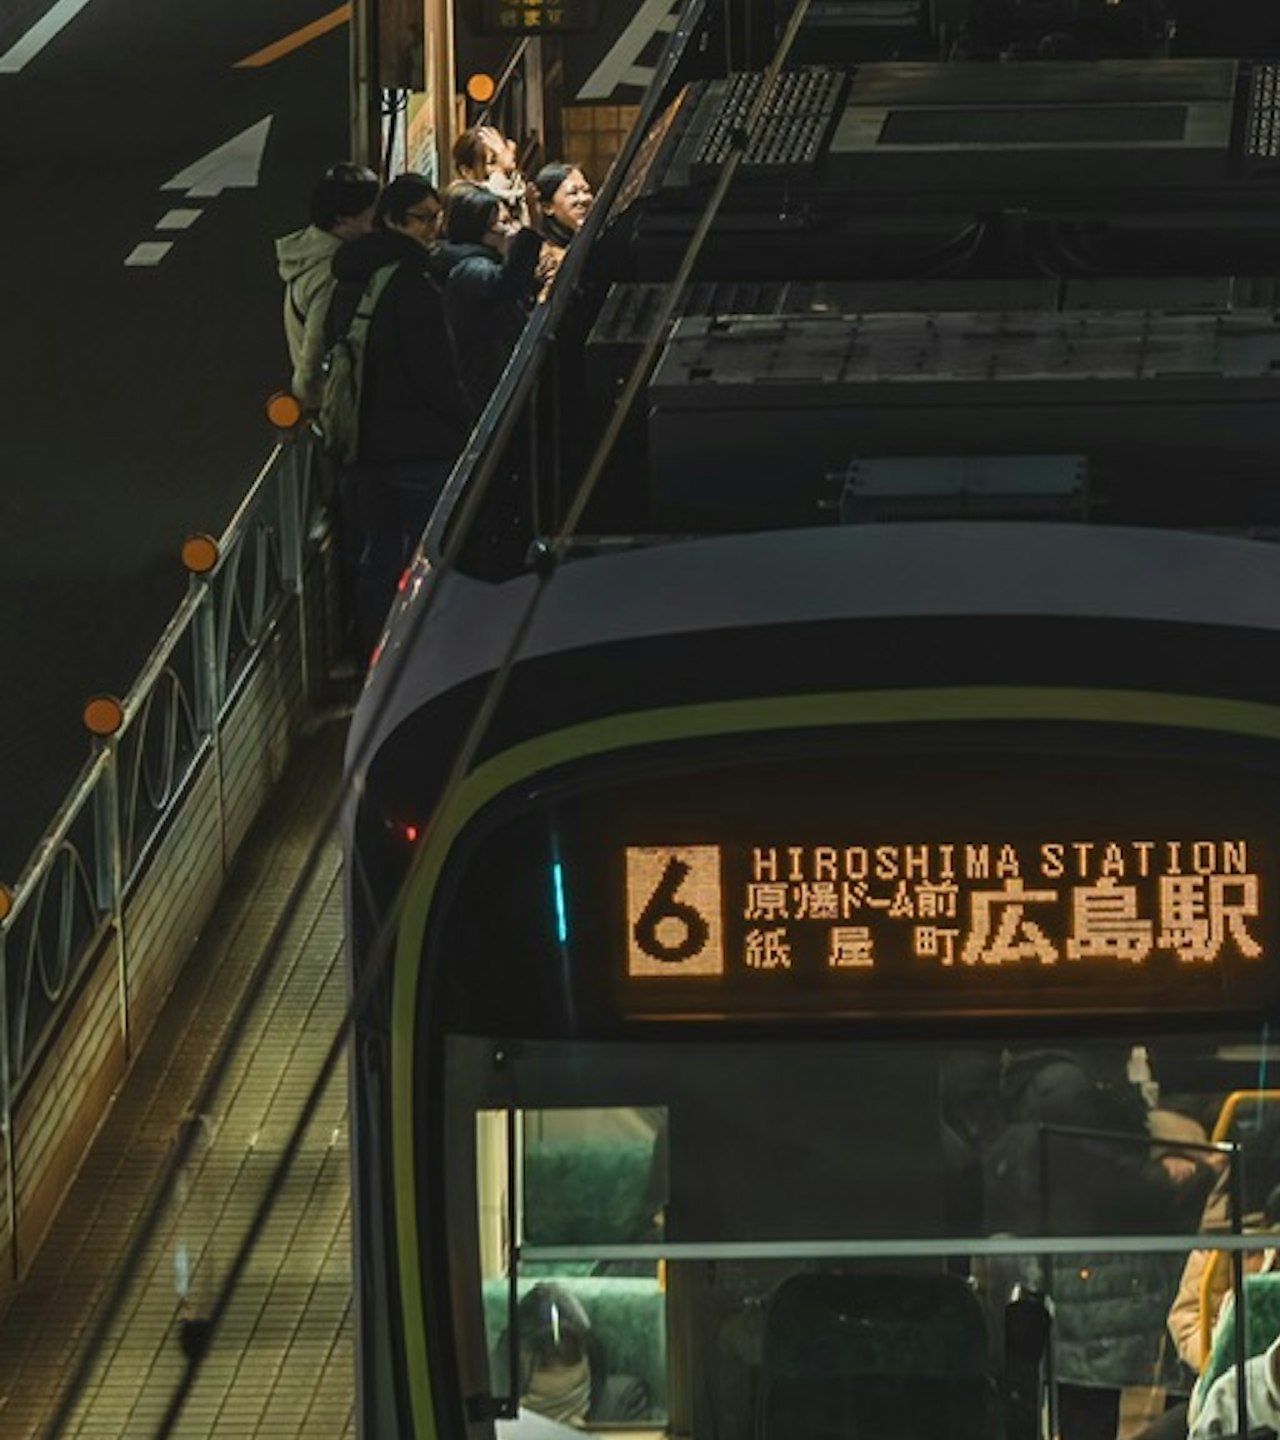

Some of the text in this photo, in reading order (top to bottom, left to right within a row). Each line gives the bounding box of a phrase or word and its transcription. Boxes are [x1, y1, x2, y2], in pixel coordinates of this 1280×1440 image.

[752, 839, 1249, 882] HIROSHIMA STATION
[633, 856, 709, 963] 6
[744, 879, 960, 921] 原爆ドーム前
[960, 875, 1264, 965] 広島駅
[744, 926, 960, 970] 紙屋町
